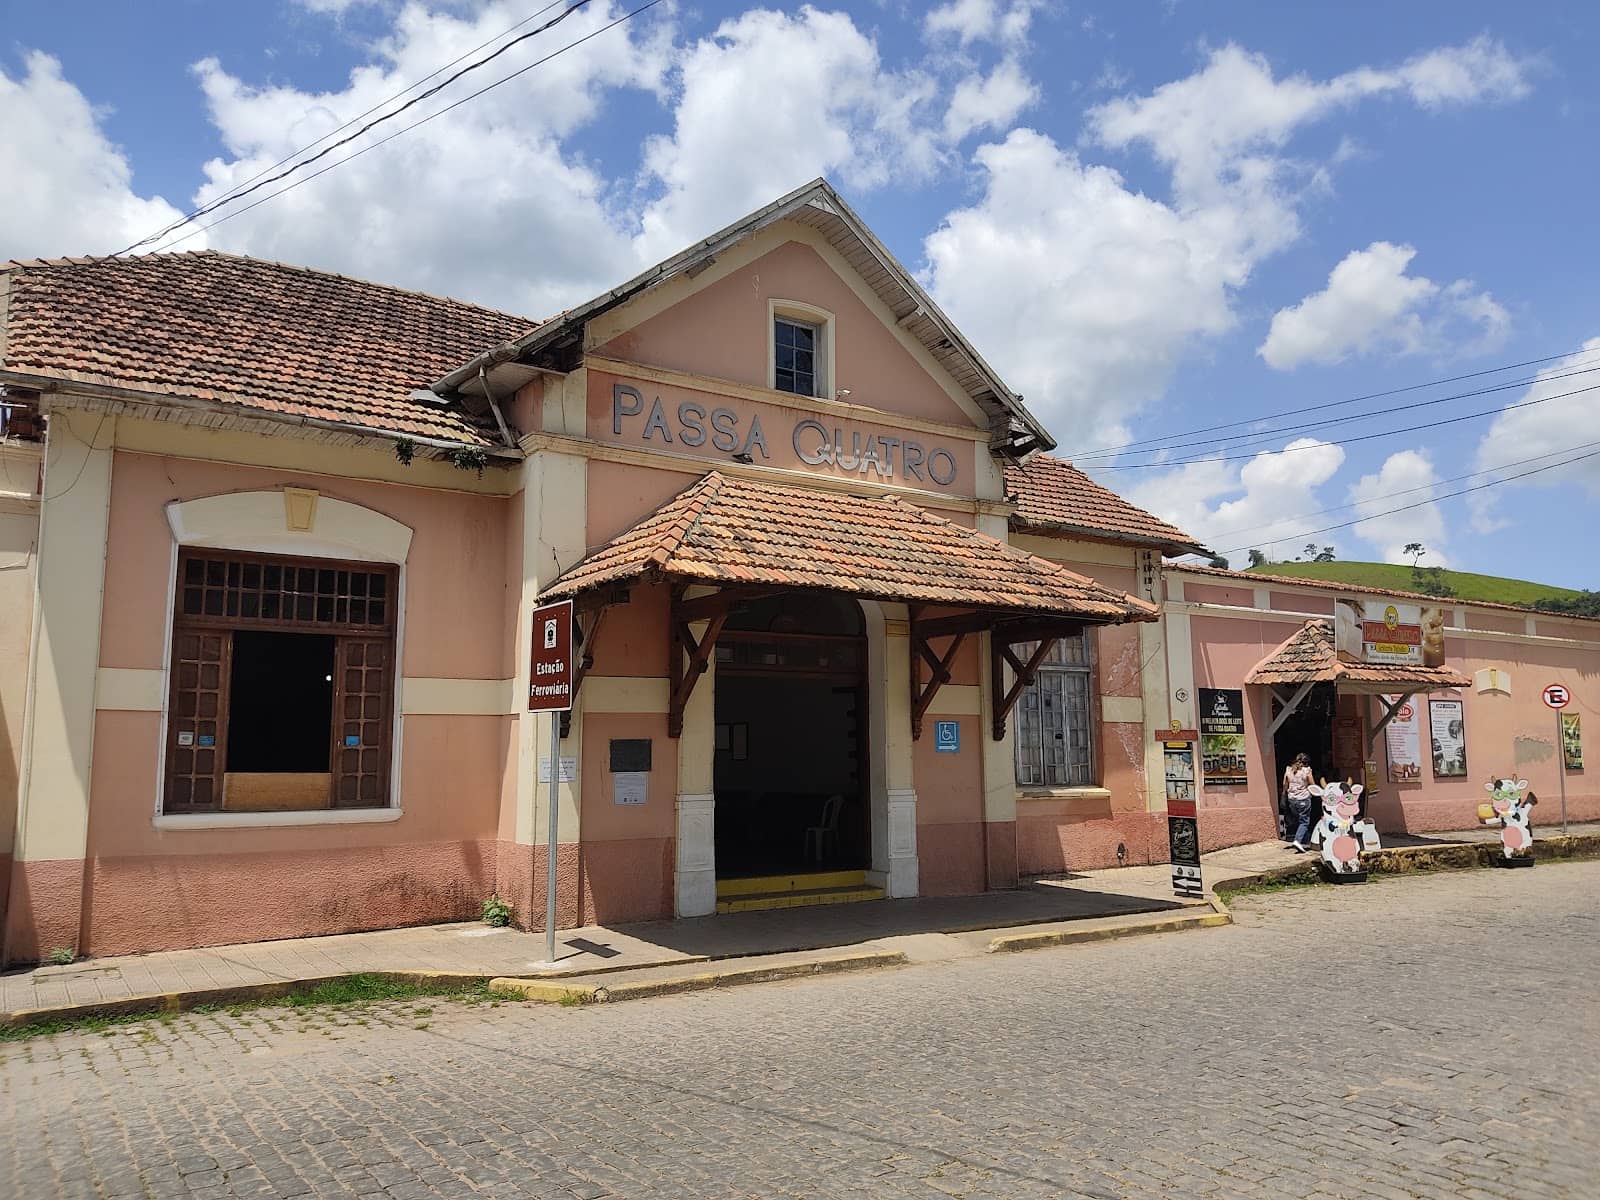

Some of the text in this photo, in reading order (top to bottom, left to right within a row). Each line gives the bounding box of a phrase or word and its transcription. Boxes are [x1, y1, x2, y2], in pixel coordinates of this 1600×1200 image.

[613, 383, 958, 486] PASSA QUATRO
[536, 659, 564, 675] Estação
[531, 680, 569, 696] Ferroviária
